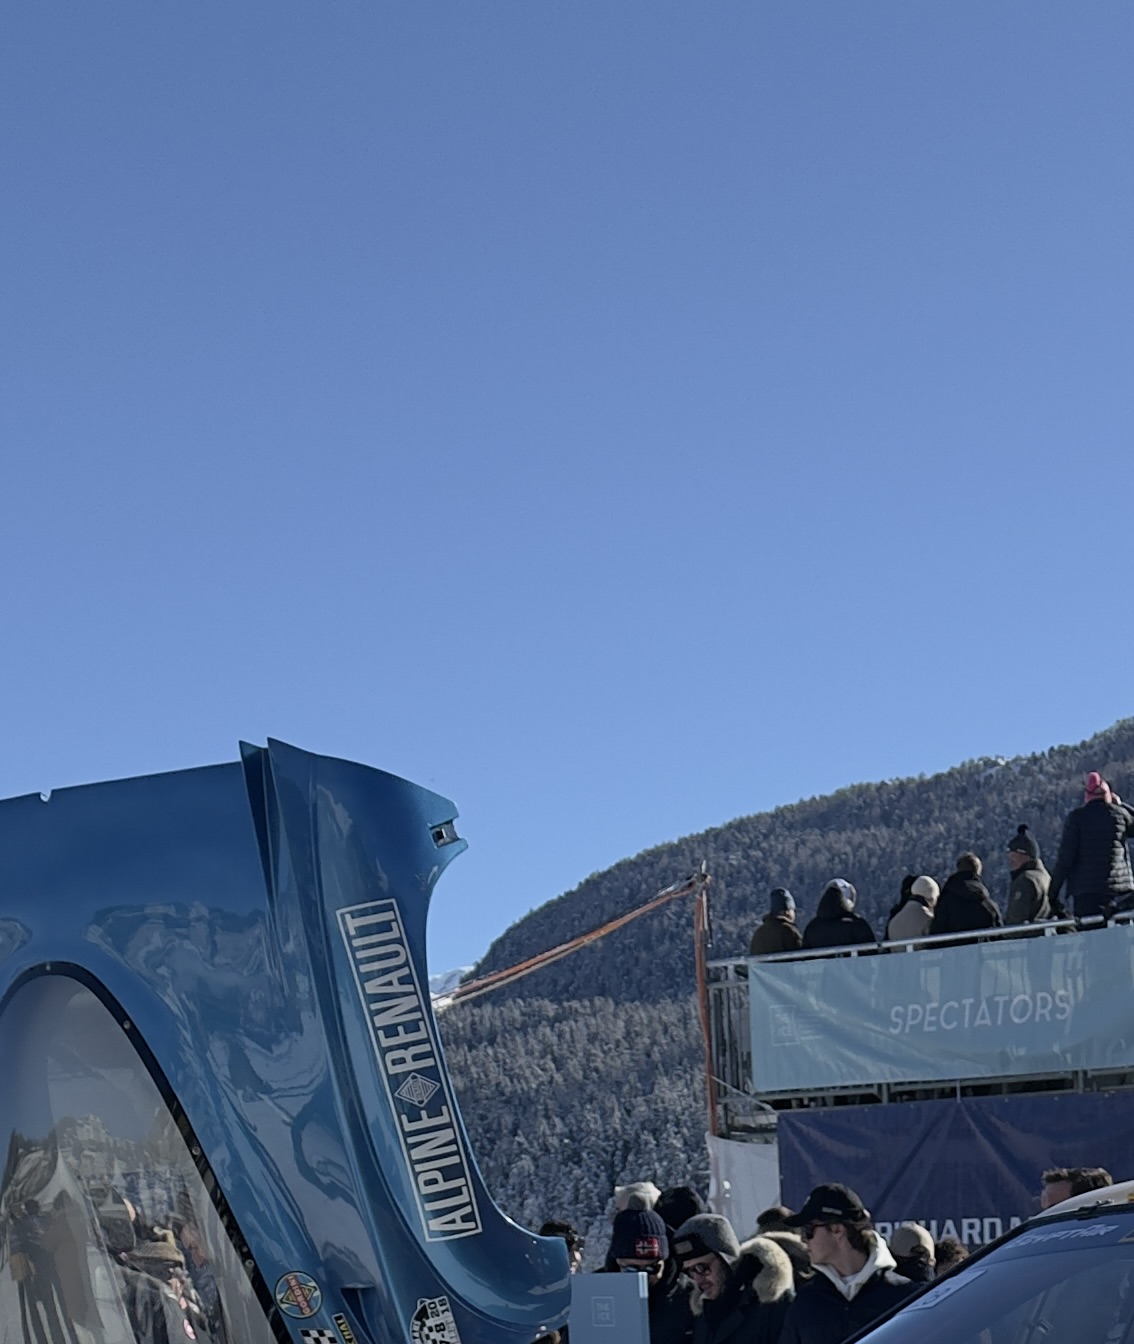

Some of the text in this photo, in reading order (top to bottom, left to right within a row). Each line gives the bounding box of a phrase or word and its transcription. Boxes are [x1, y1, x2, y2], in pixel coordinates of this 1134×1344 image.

[347, 908, 477, 1231] ALPINE RENAULT
[888, 989, 1071, 1035] SPECTATORS
